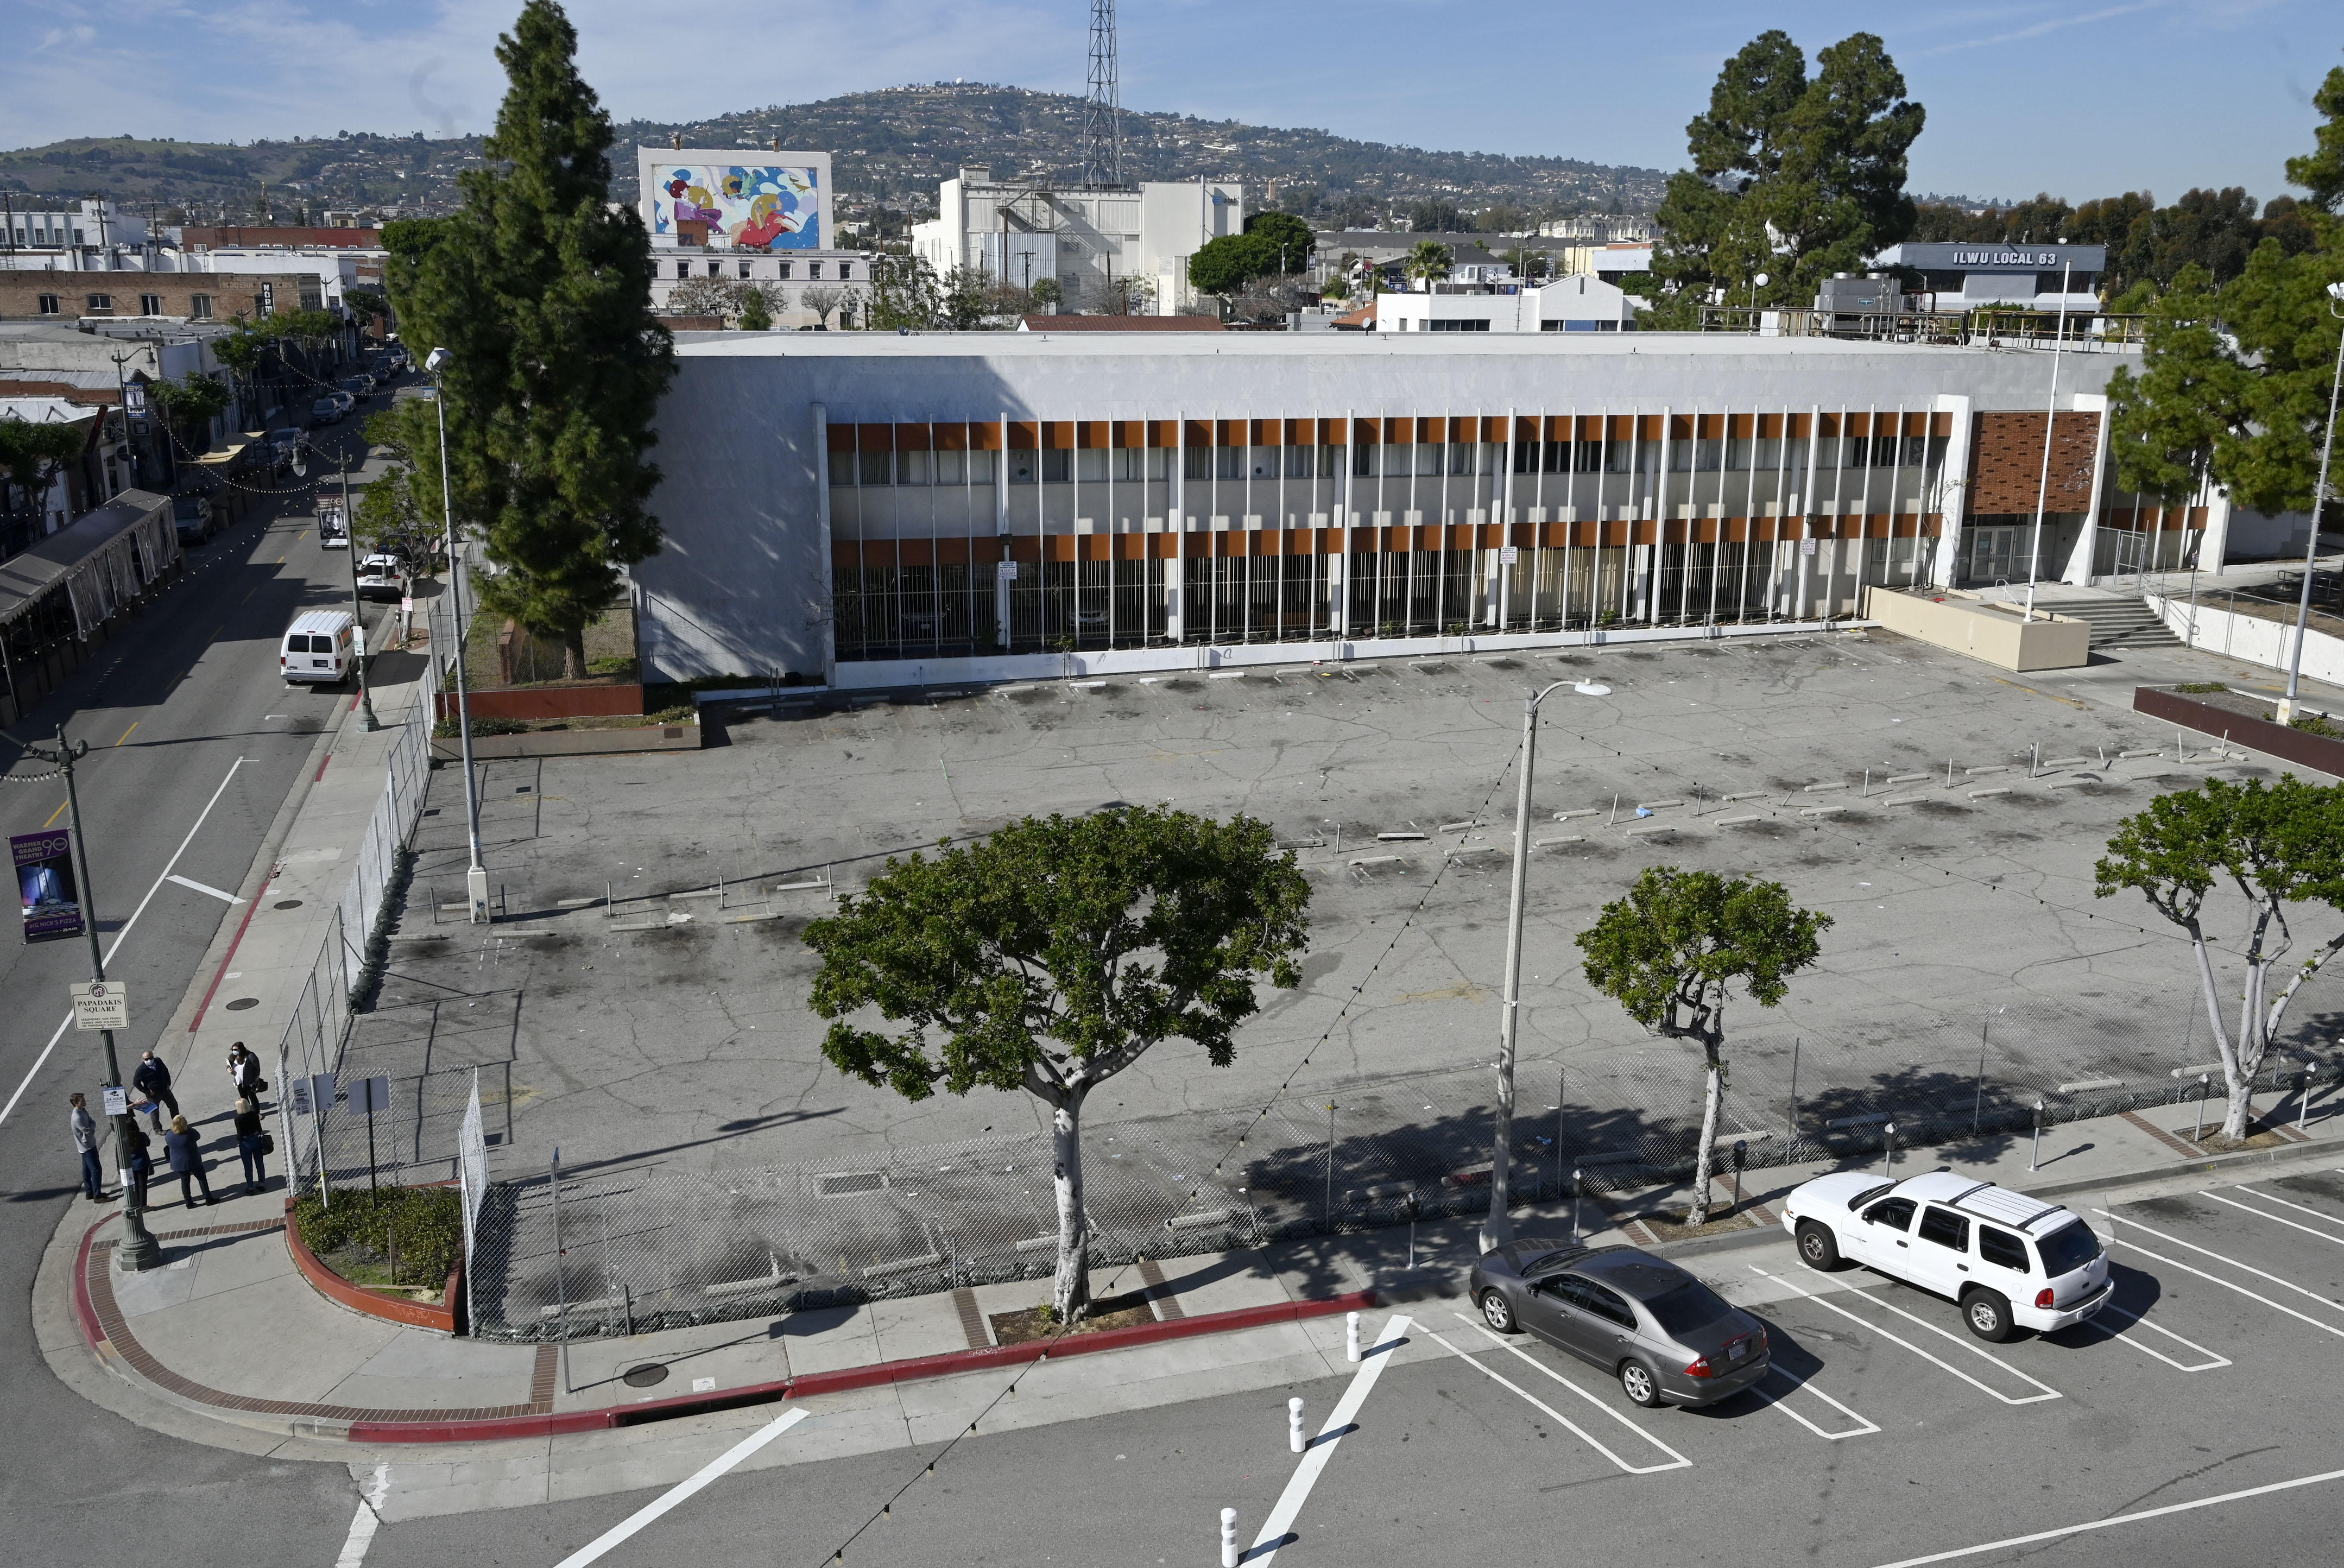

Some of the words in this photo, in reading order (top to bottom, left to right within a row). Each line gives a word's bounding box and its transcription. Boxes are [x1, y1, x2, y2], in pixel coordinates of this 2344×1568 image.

[1953, 252, 1989, 264] ILWU
[1993, 252, 2033, 264] LOCAL
[2038, 253, 2056, 264] 63
[13, 841, 41, 849] WARNER
[42, 837, 68, 856] 90
[15, 852, 43, 861] THEATRE
